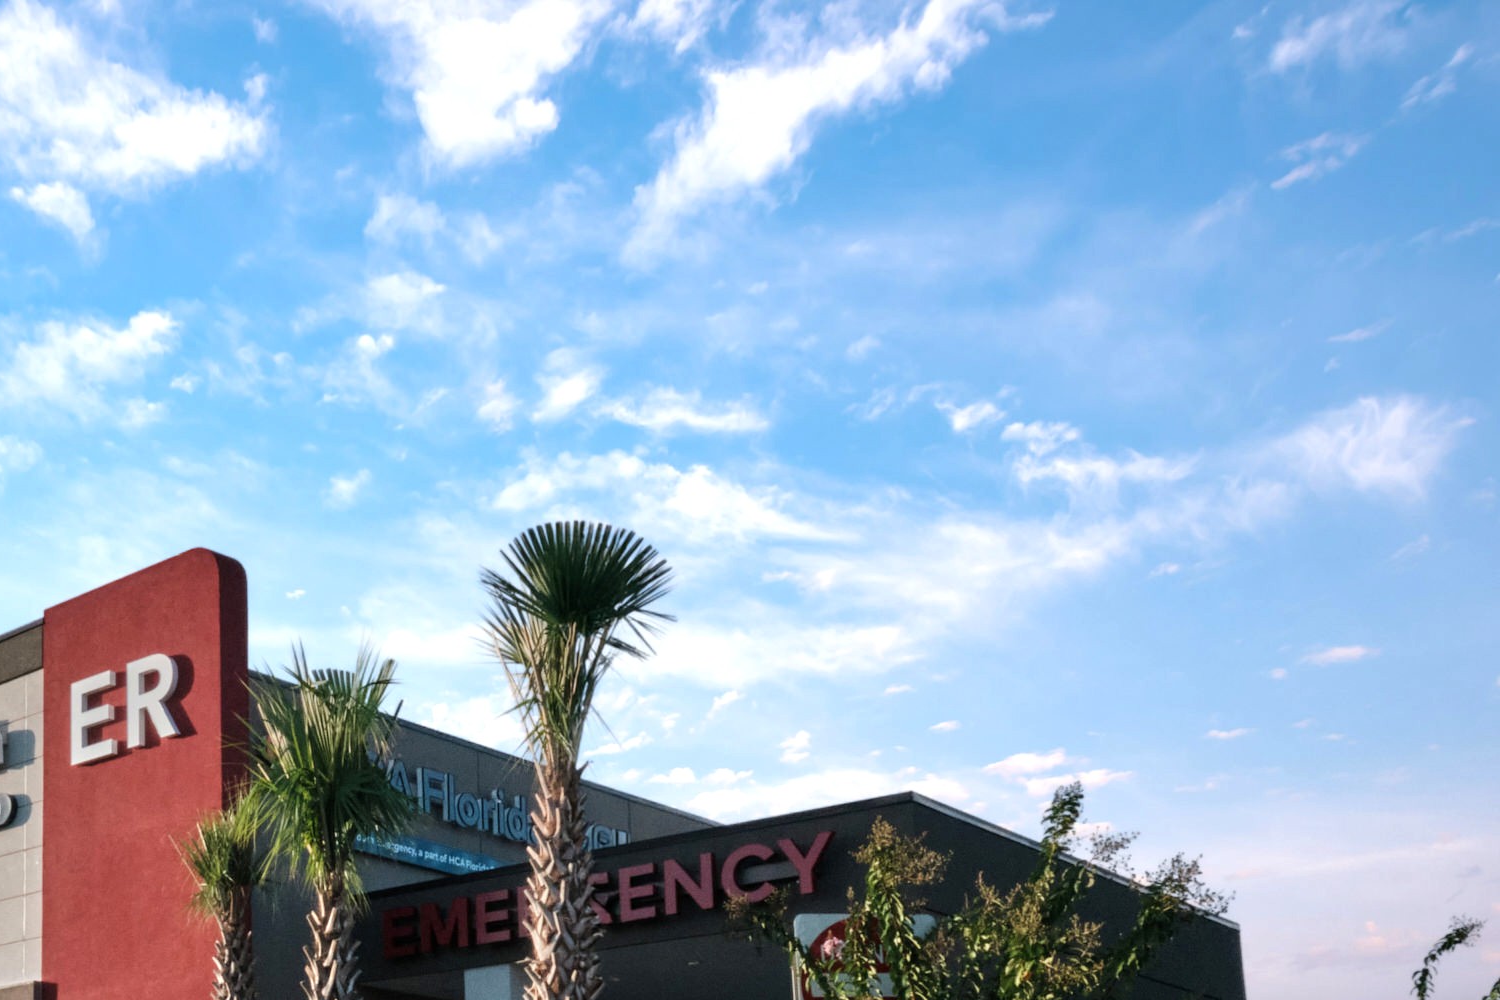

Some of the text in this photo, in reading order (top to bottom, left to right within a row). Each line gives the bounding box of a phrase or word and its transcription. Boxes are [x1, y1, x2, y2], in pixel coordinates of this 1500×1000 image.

[70, 652, 183, 766] ER
[383, 831, 835, 960] EMEENCY
[418, 849, 424, 857] a
[424, 850, 439, 862] part
[439, 853, 448, 863] of
[448, 855, 465, 867] HCA
